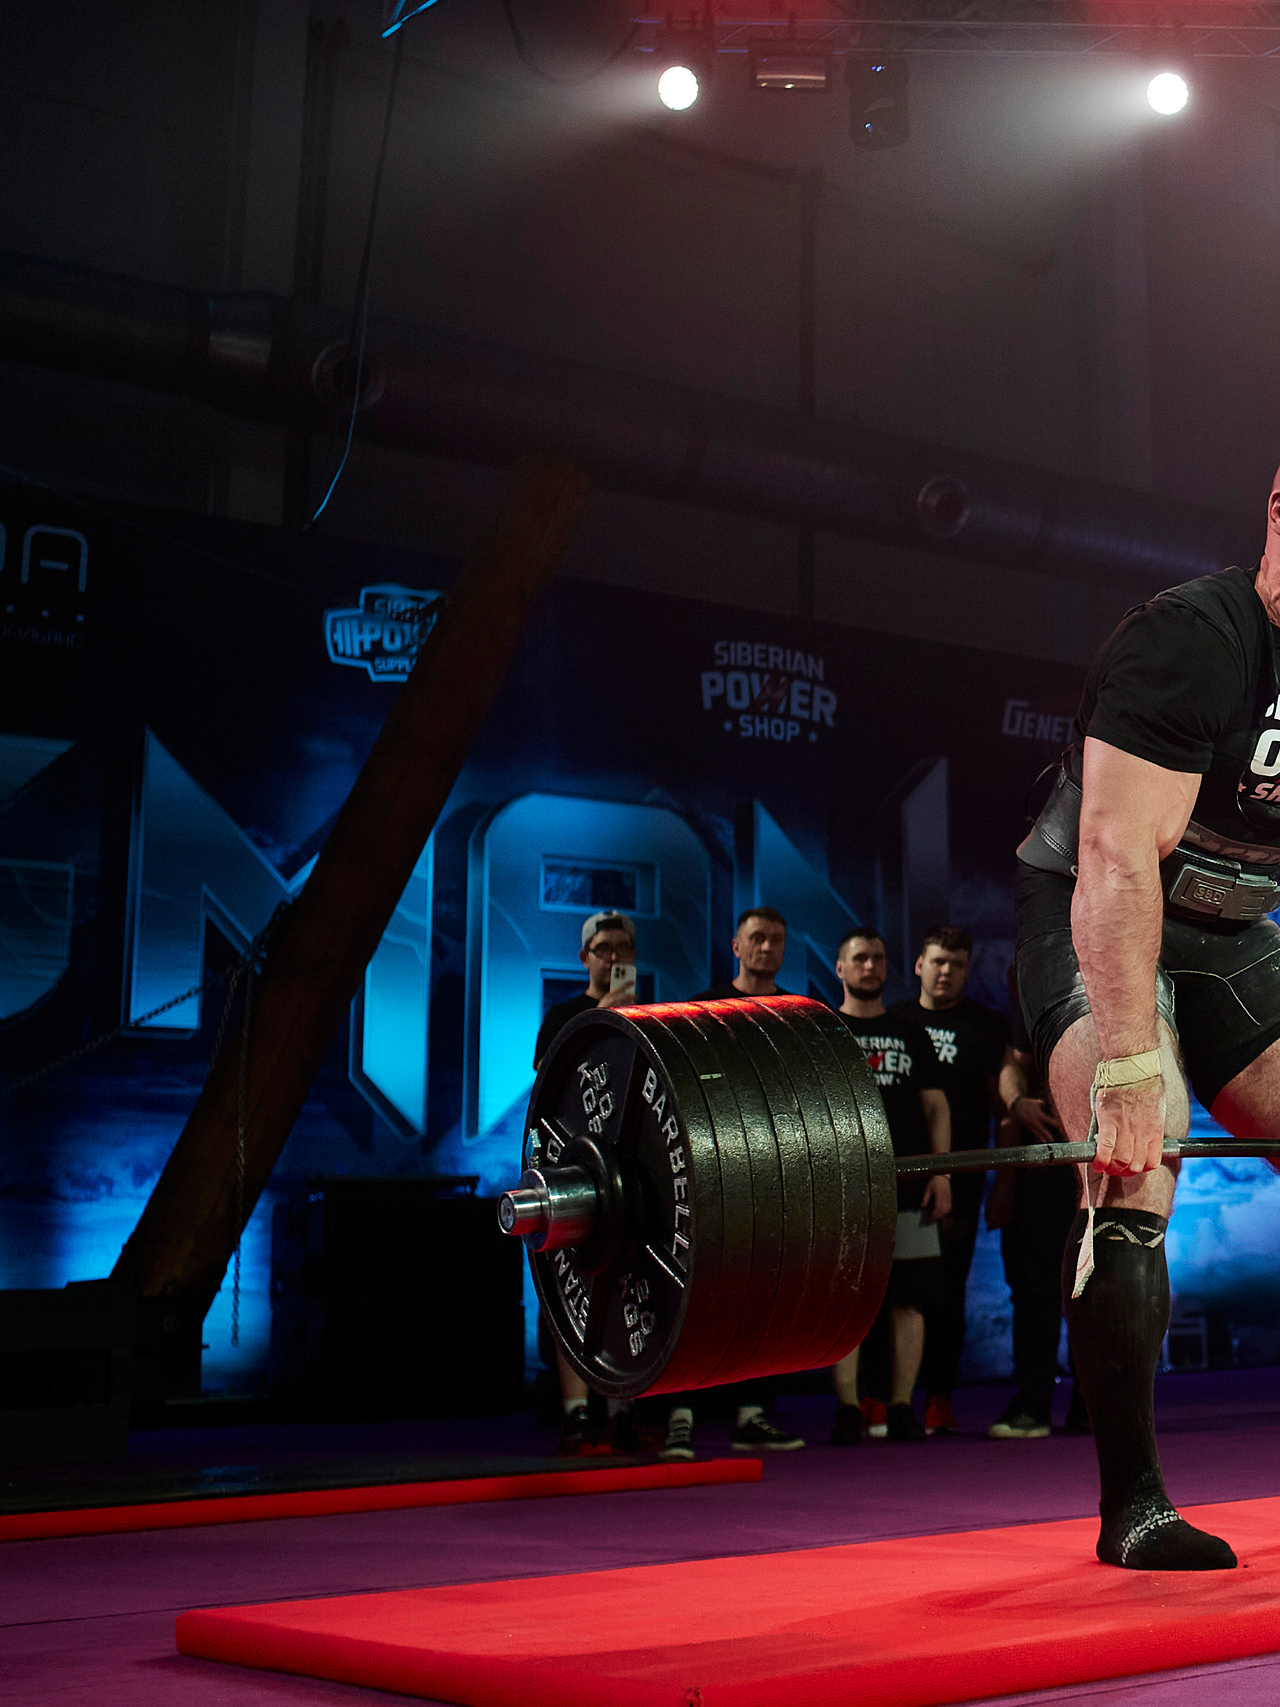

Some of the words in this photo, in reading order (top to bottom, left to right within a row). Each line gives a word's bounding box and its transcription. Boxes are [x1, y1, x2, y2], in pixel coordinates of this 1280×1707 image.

[713, 640, 825, 682] SIBERIAN
[701, 670, 838, 727] POWER
[739, 714, 800, 742] SHOP
[1002, 699, 1077, 744] GENET
[1197, 887, 1222, 901] SBD
[641, 1066, 691, 1257] BARBELL
